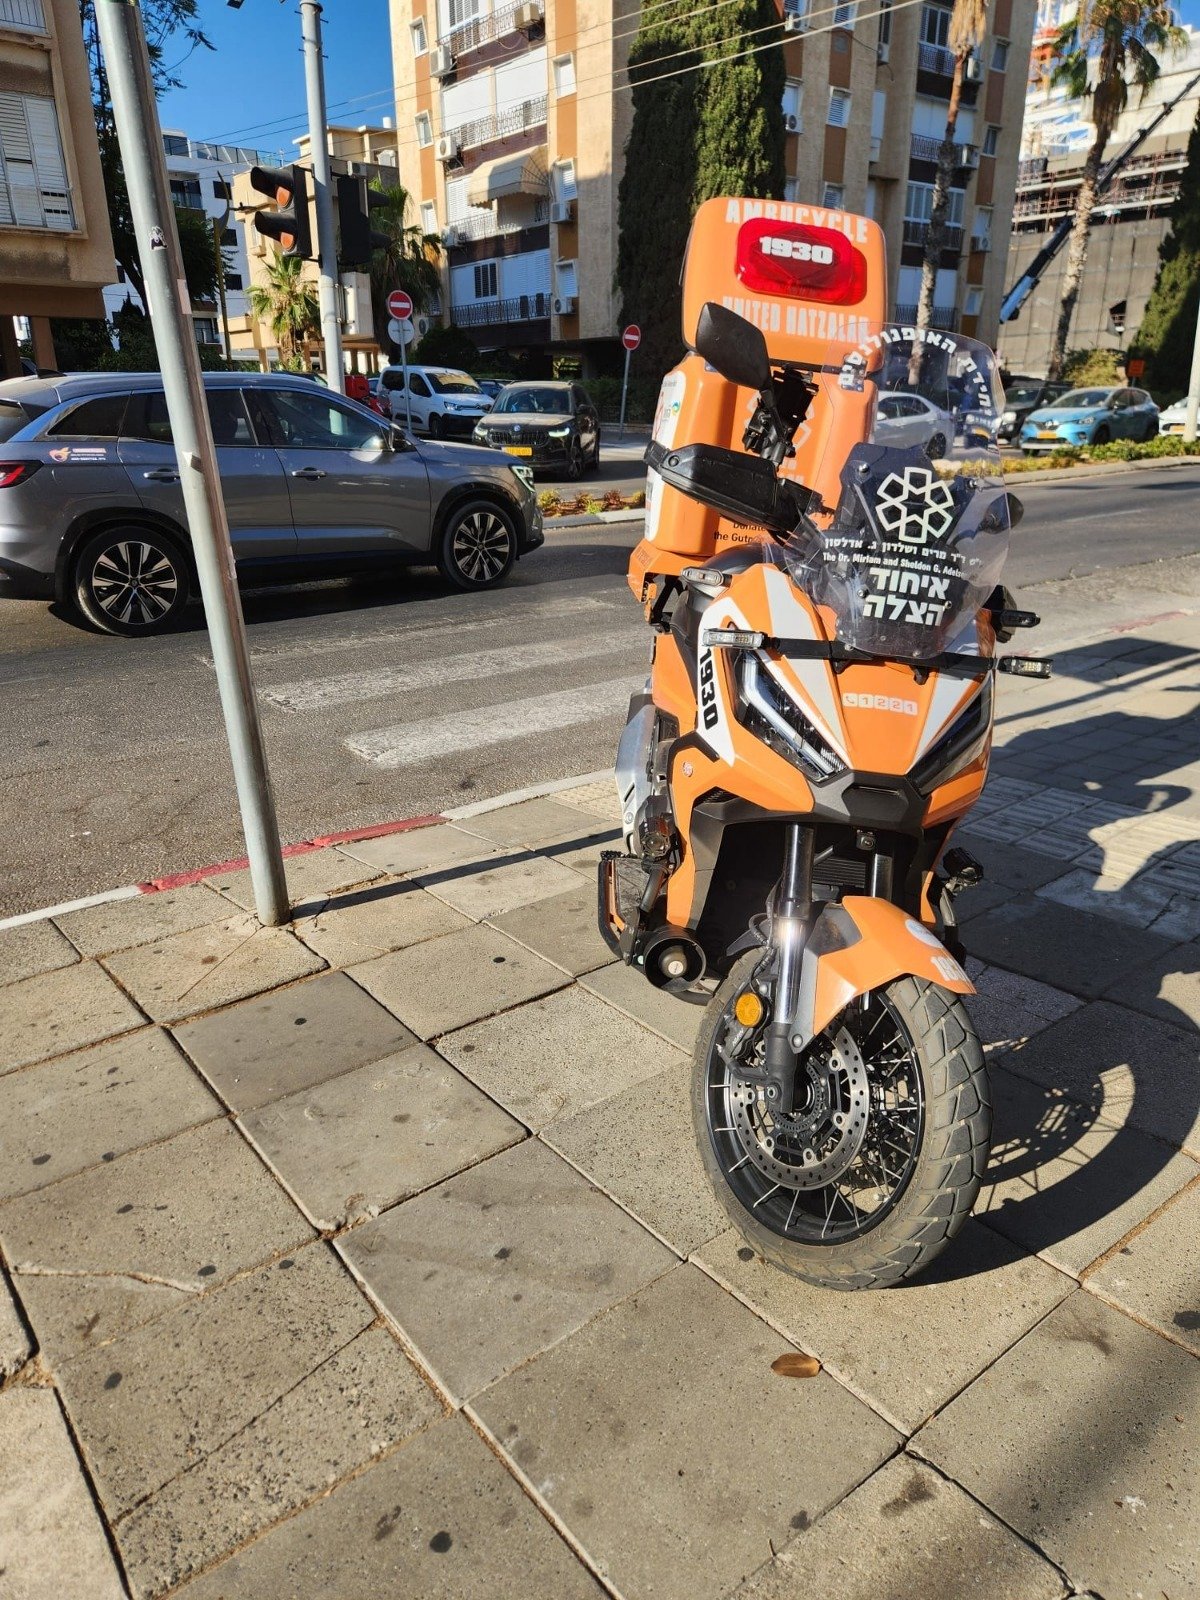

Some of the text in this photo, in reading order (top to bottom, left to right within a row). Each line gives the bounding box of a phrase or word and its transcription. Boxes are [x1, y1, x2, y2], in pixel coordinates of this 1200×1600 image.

[725, 199, 868, 243] AMBUCYCLE
[759, 236, 833, 265] 1930
[713, 532, 729, 541] the
[881, 541, 917, 556] ושלדון
[823, 552, 968, 579] The Dr. Miriam and Sheldon G. Adels
[922, 548, 947, 560] מרים
[869, 566, 950, 601] איחוד
[862, 594, 946, 627] הצלה
[699, 648, 719, 730] 1930
[861, 696, 914, 713] 1221
